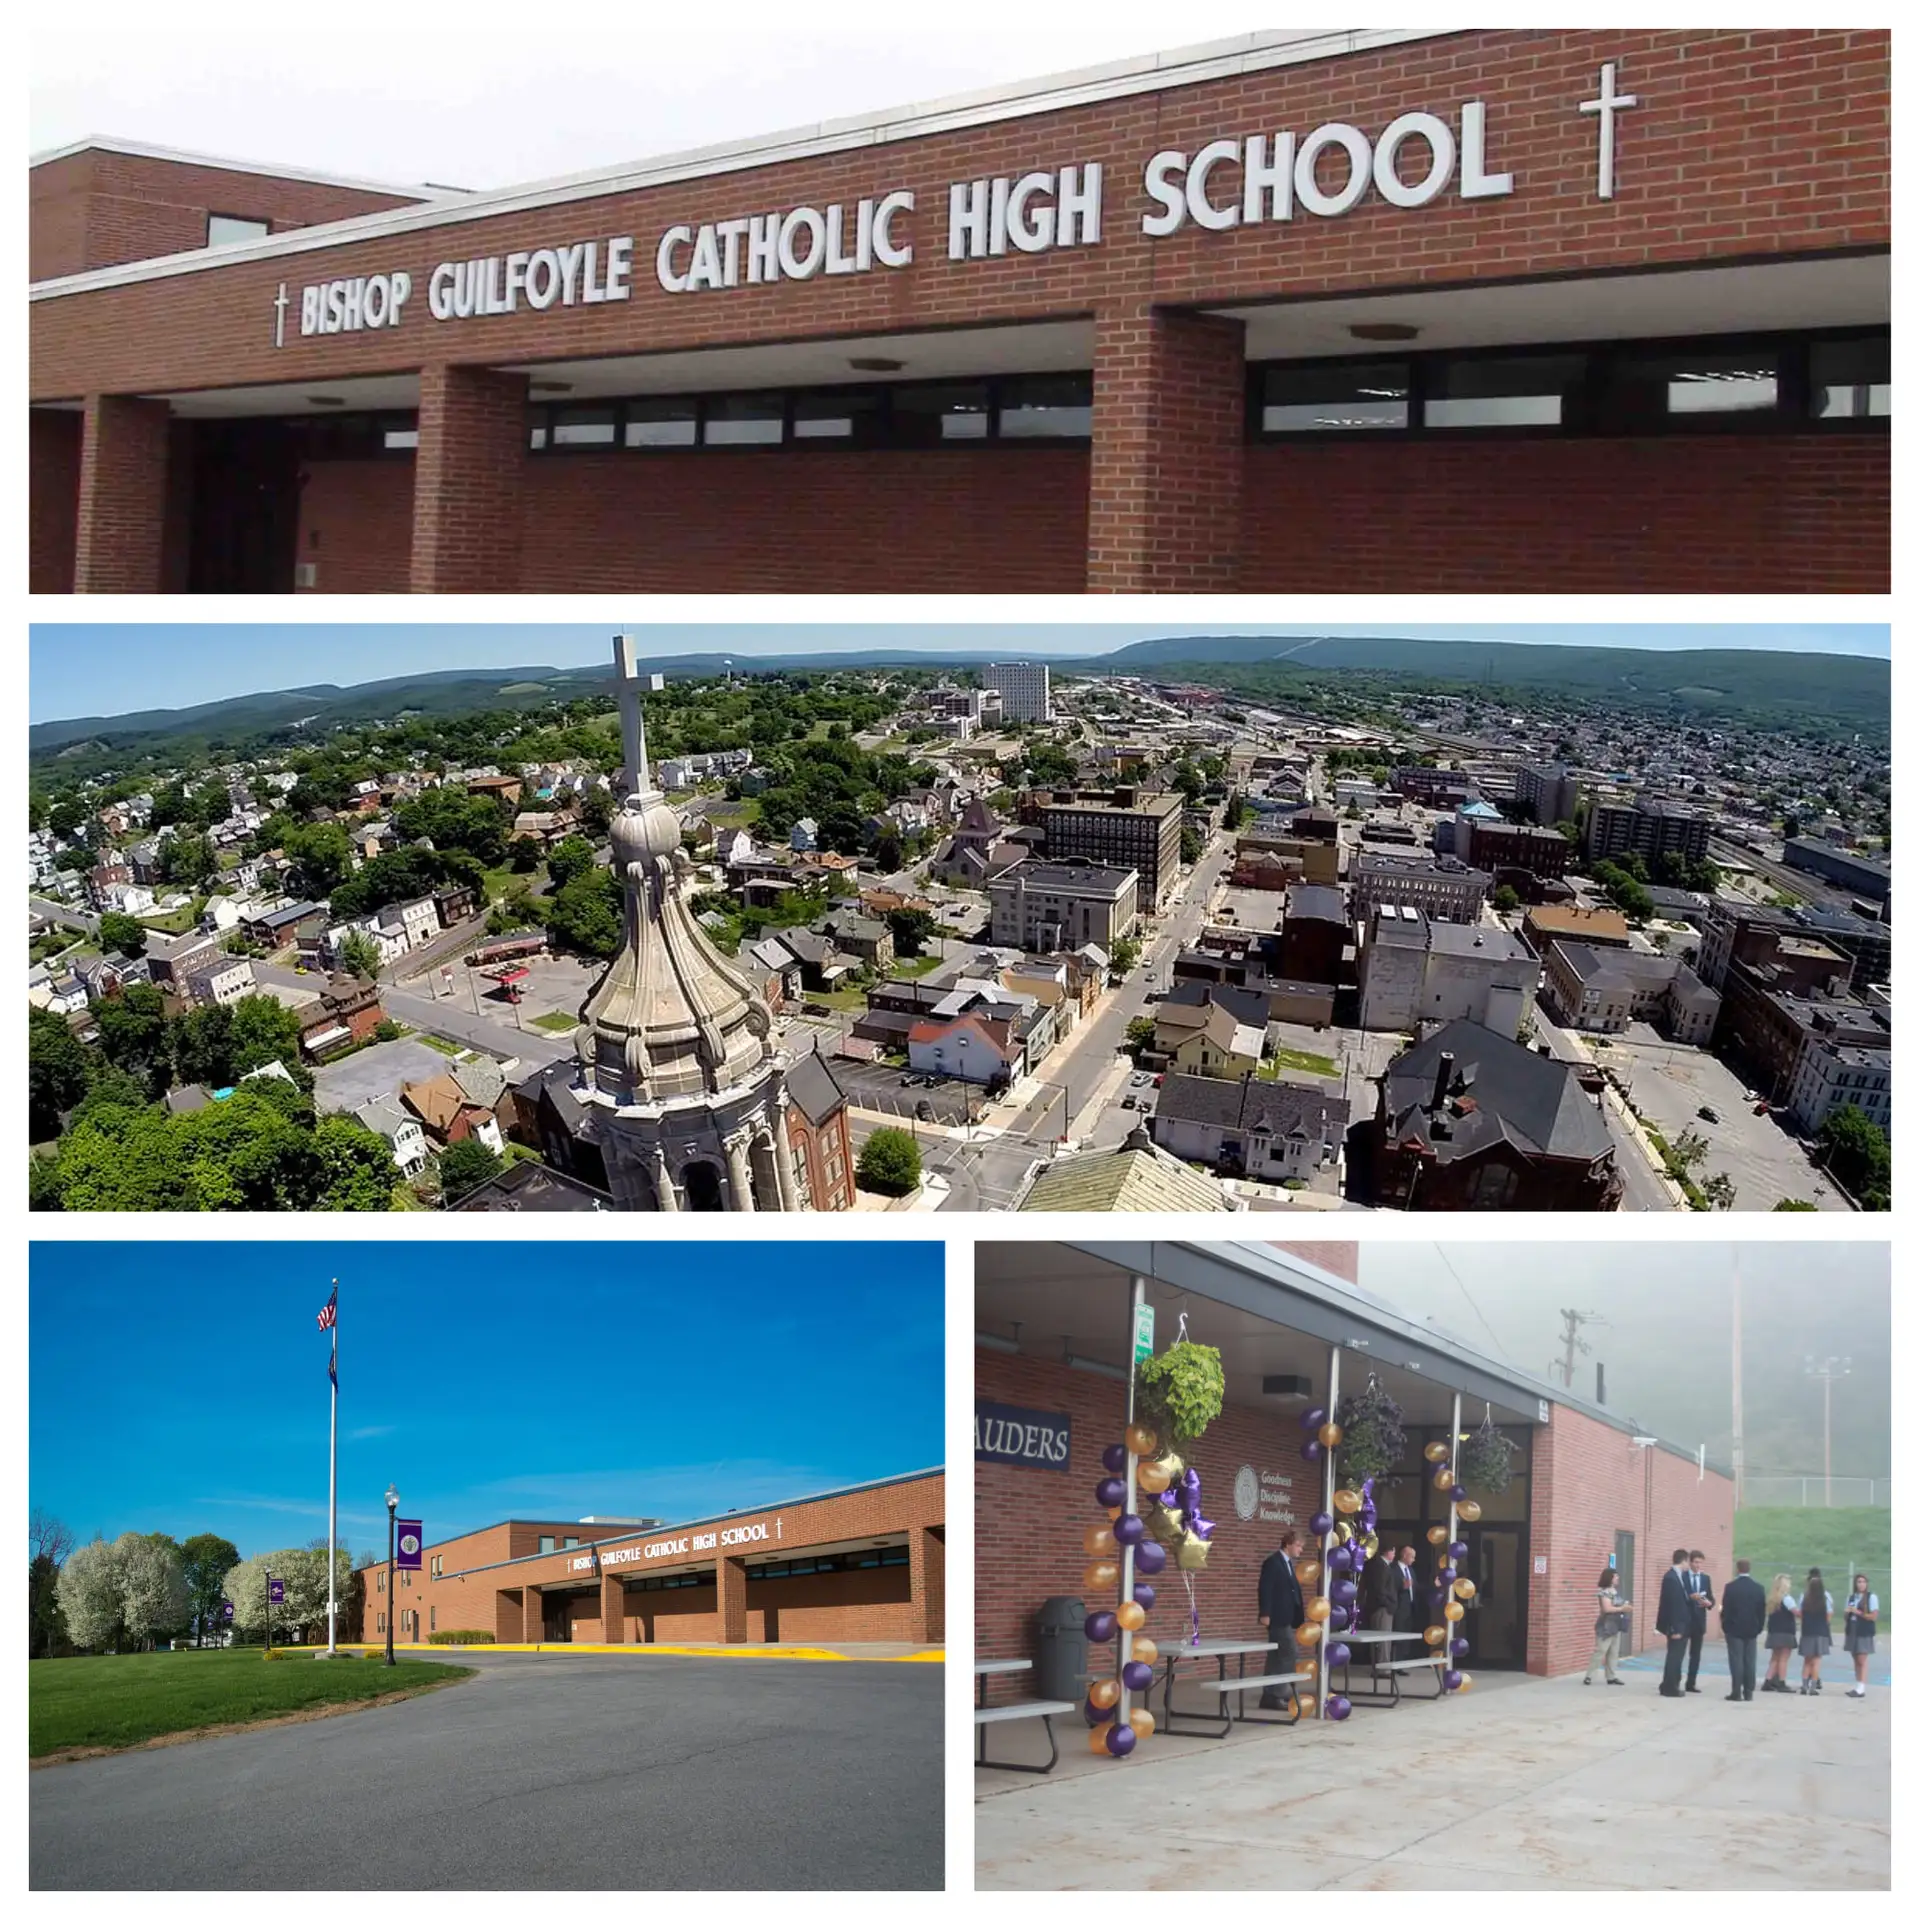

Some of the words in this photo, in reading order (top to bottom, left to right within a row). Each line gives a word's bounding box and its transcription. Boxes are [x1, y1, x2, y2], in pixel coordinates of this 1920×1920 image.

[300, 272, 411, 336] BISHOP
[429, 235, 633, 322] GUILFOYLE
[656, 190, 915, 294] CATHOLIC
[948, 161, 1102, 260] HIGH
[1142, 100, 1514, 237] SCHOOL
[1261, 1471, 1292, 1487] Goodness
[1260, 1489, 1291, 1506] Discipline
[1260, 1507, 1295, 1526] Knowledge
[573, 1556, 597, 1570] BISHOP
[600, 1547, 641, 1566] GUILFOYLE
[644, 1538, 688, 1558] CATHOLIC
[693, 1533, 717, 1550] HIGH
[721, 1523, 769, 1546] SCHOOL
